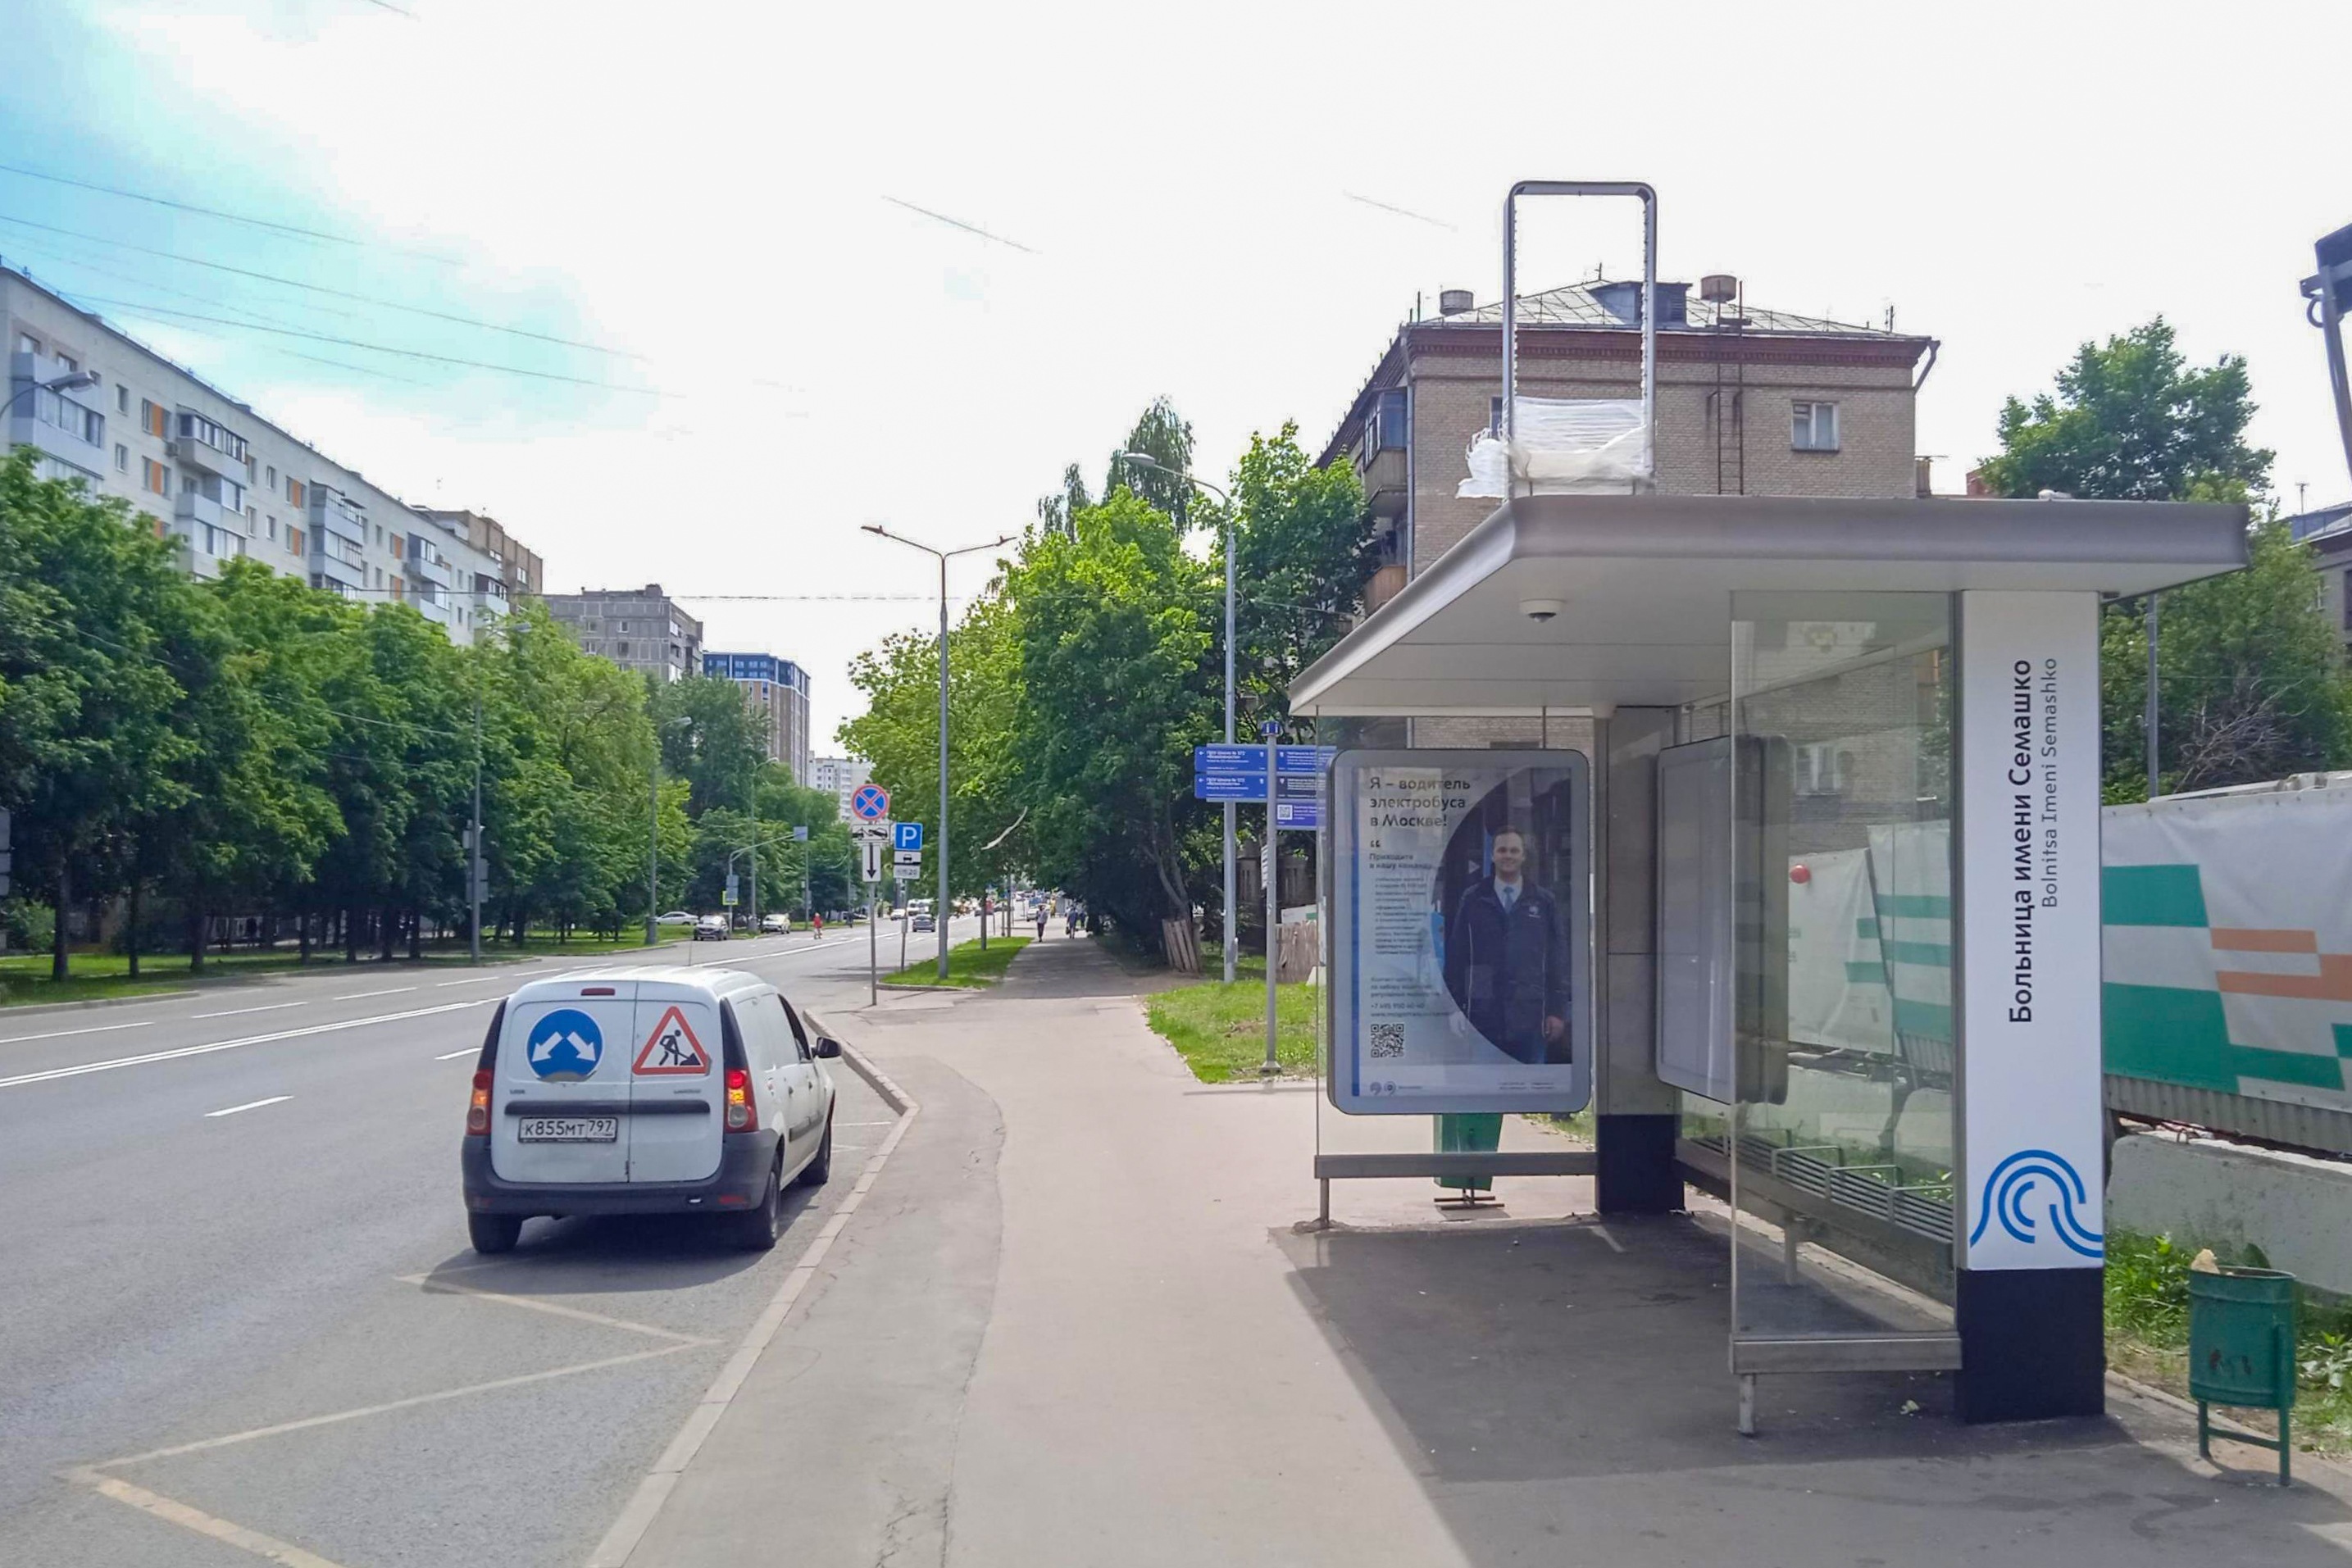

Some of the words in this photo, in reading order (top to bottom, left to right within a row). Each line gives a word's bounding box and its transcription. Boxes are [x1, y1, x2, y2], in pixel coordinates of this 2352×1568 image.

[2007, 659, 2031, 787] Семашко
[2040, 658, 2058, 758] Semashko
[1370, 776, 1381, 789] Я
[1399, 779, 1471, 791] водитель
[1370, 796, 1466, 811] электробуса
[2040, 764, 2058, 823] Imeni
[902, 826, 917, 848] P
[1370, 817, 1379, 827] в
[1382, 814, 1447, 827] Москве!
[2013, 794, 2032, 881] имени
[2040, 829, 2059, 908] Bolnitsa
[2008, 889, 2036, 1023] Больница
[525, 1120, 585, 1136] К855МТ
[588, 1120, 612, 1132] 797
